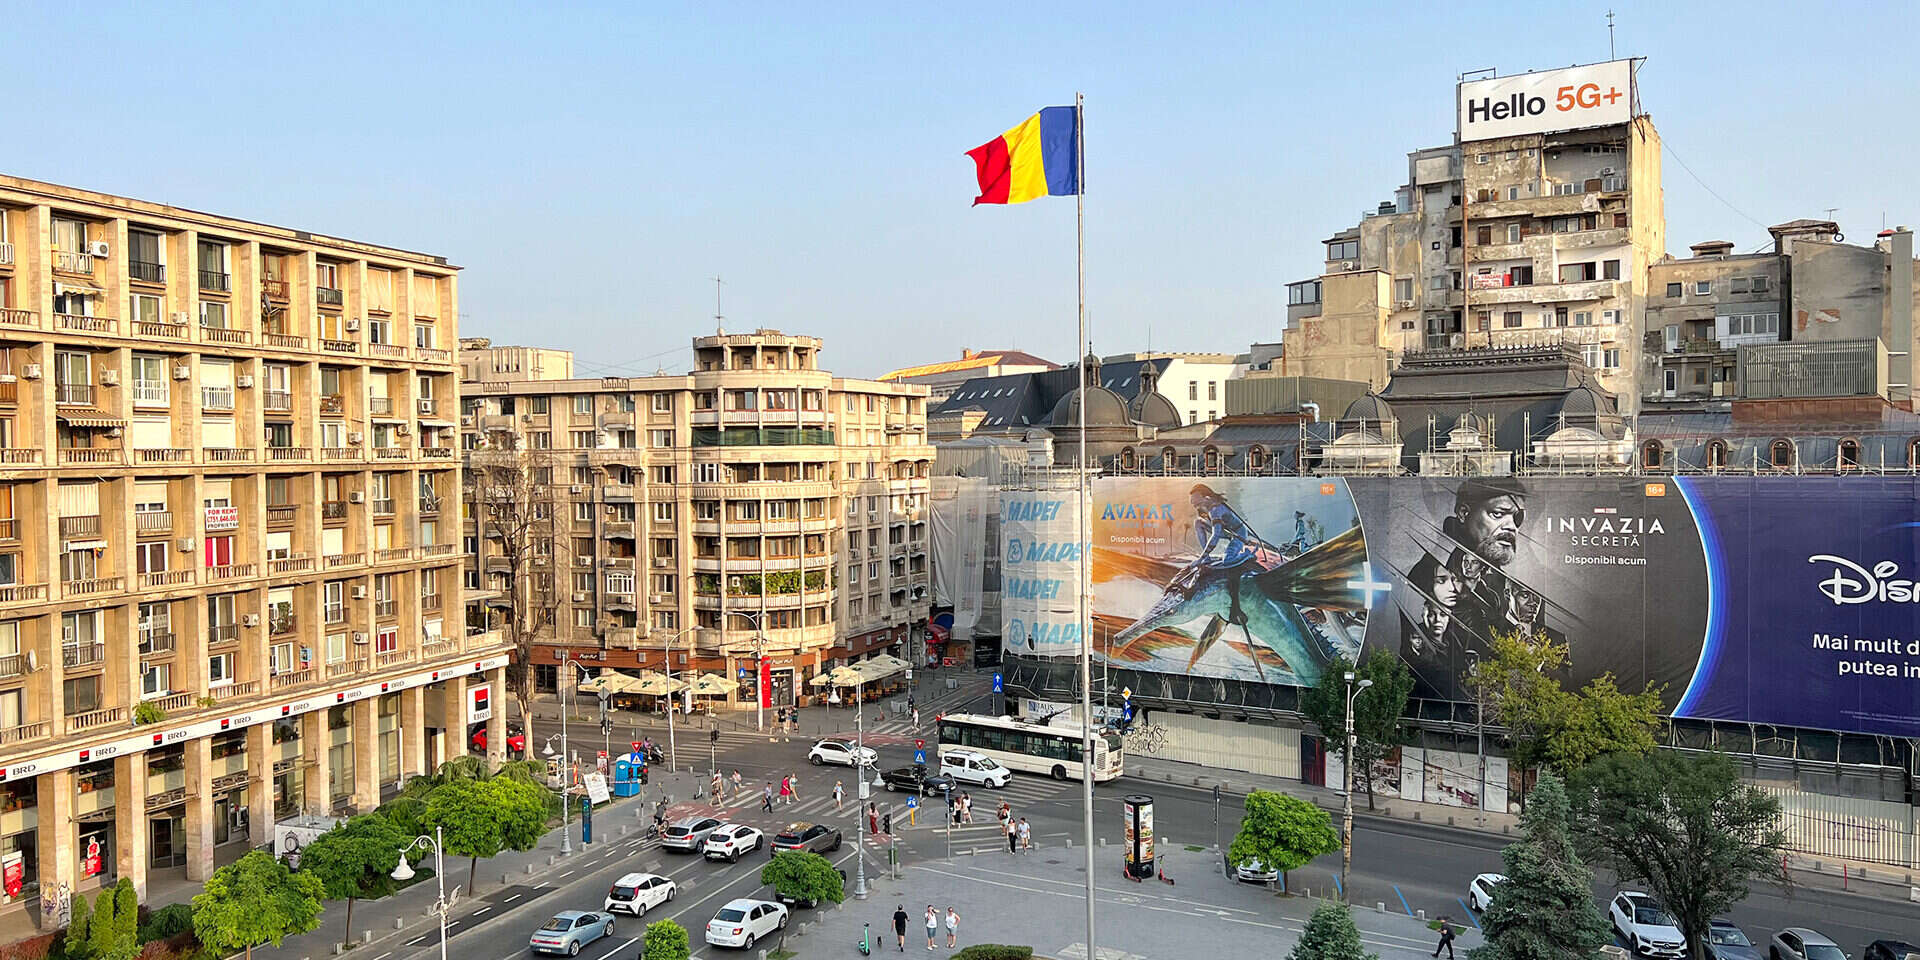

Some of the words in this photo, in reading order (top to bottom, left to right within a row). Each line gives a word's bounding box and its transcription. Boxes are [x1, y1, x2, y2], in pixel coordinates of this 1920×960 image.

[1468, 92, 1546, 123] Hello
[1555, 83, 1623, 112] 5G+
[1008, 501, 1064, 521] MAPEI
[1101, 503, 1175, 521] AVATAR
[1547, 517, 1665, 534] INVAZIA
[1110, 535, 1145, 544] Disponibil
[1145, 537, 1166, 545] acum
[1571, 534, 1641, 547] SECRETĂ
[1564, 554, 1616, 566] Disponibil
[1617, 556, 1647, 566] acum
[1008, 577, 1063, 599] MAPEI
[1812, 633, 1849, 651] Mai
[1854, 637, 1902, 655] mult
[1839, 660, 1898, 677] putea
[234, 716, 252, 726] BRD
[473, 710, 490, 721] BRD
[167, 730, 187, 741] BRD
[95, 746, 117, 758] BRD
[12, 763, 36, 776] BRD
